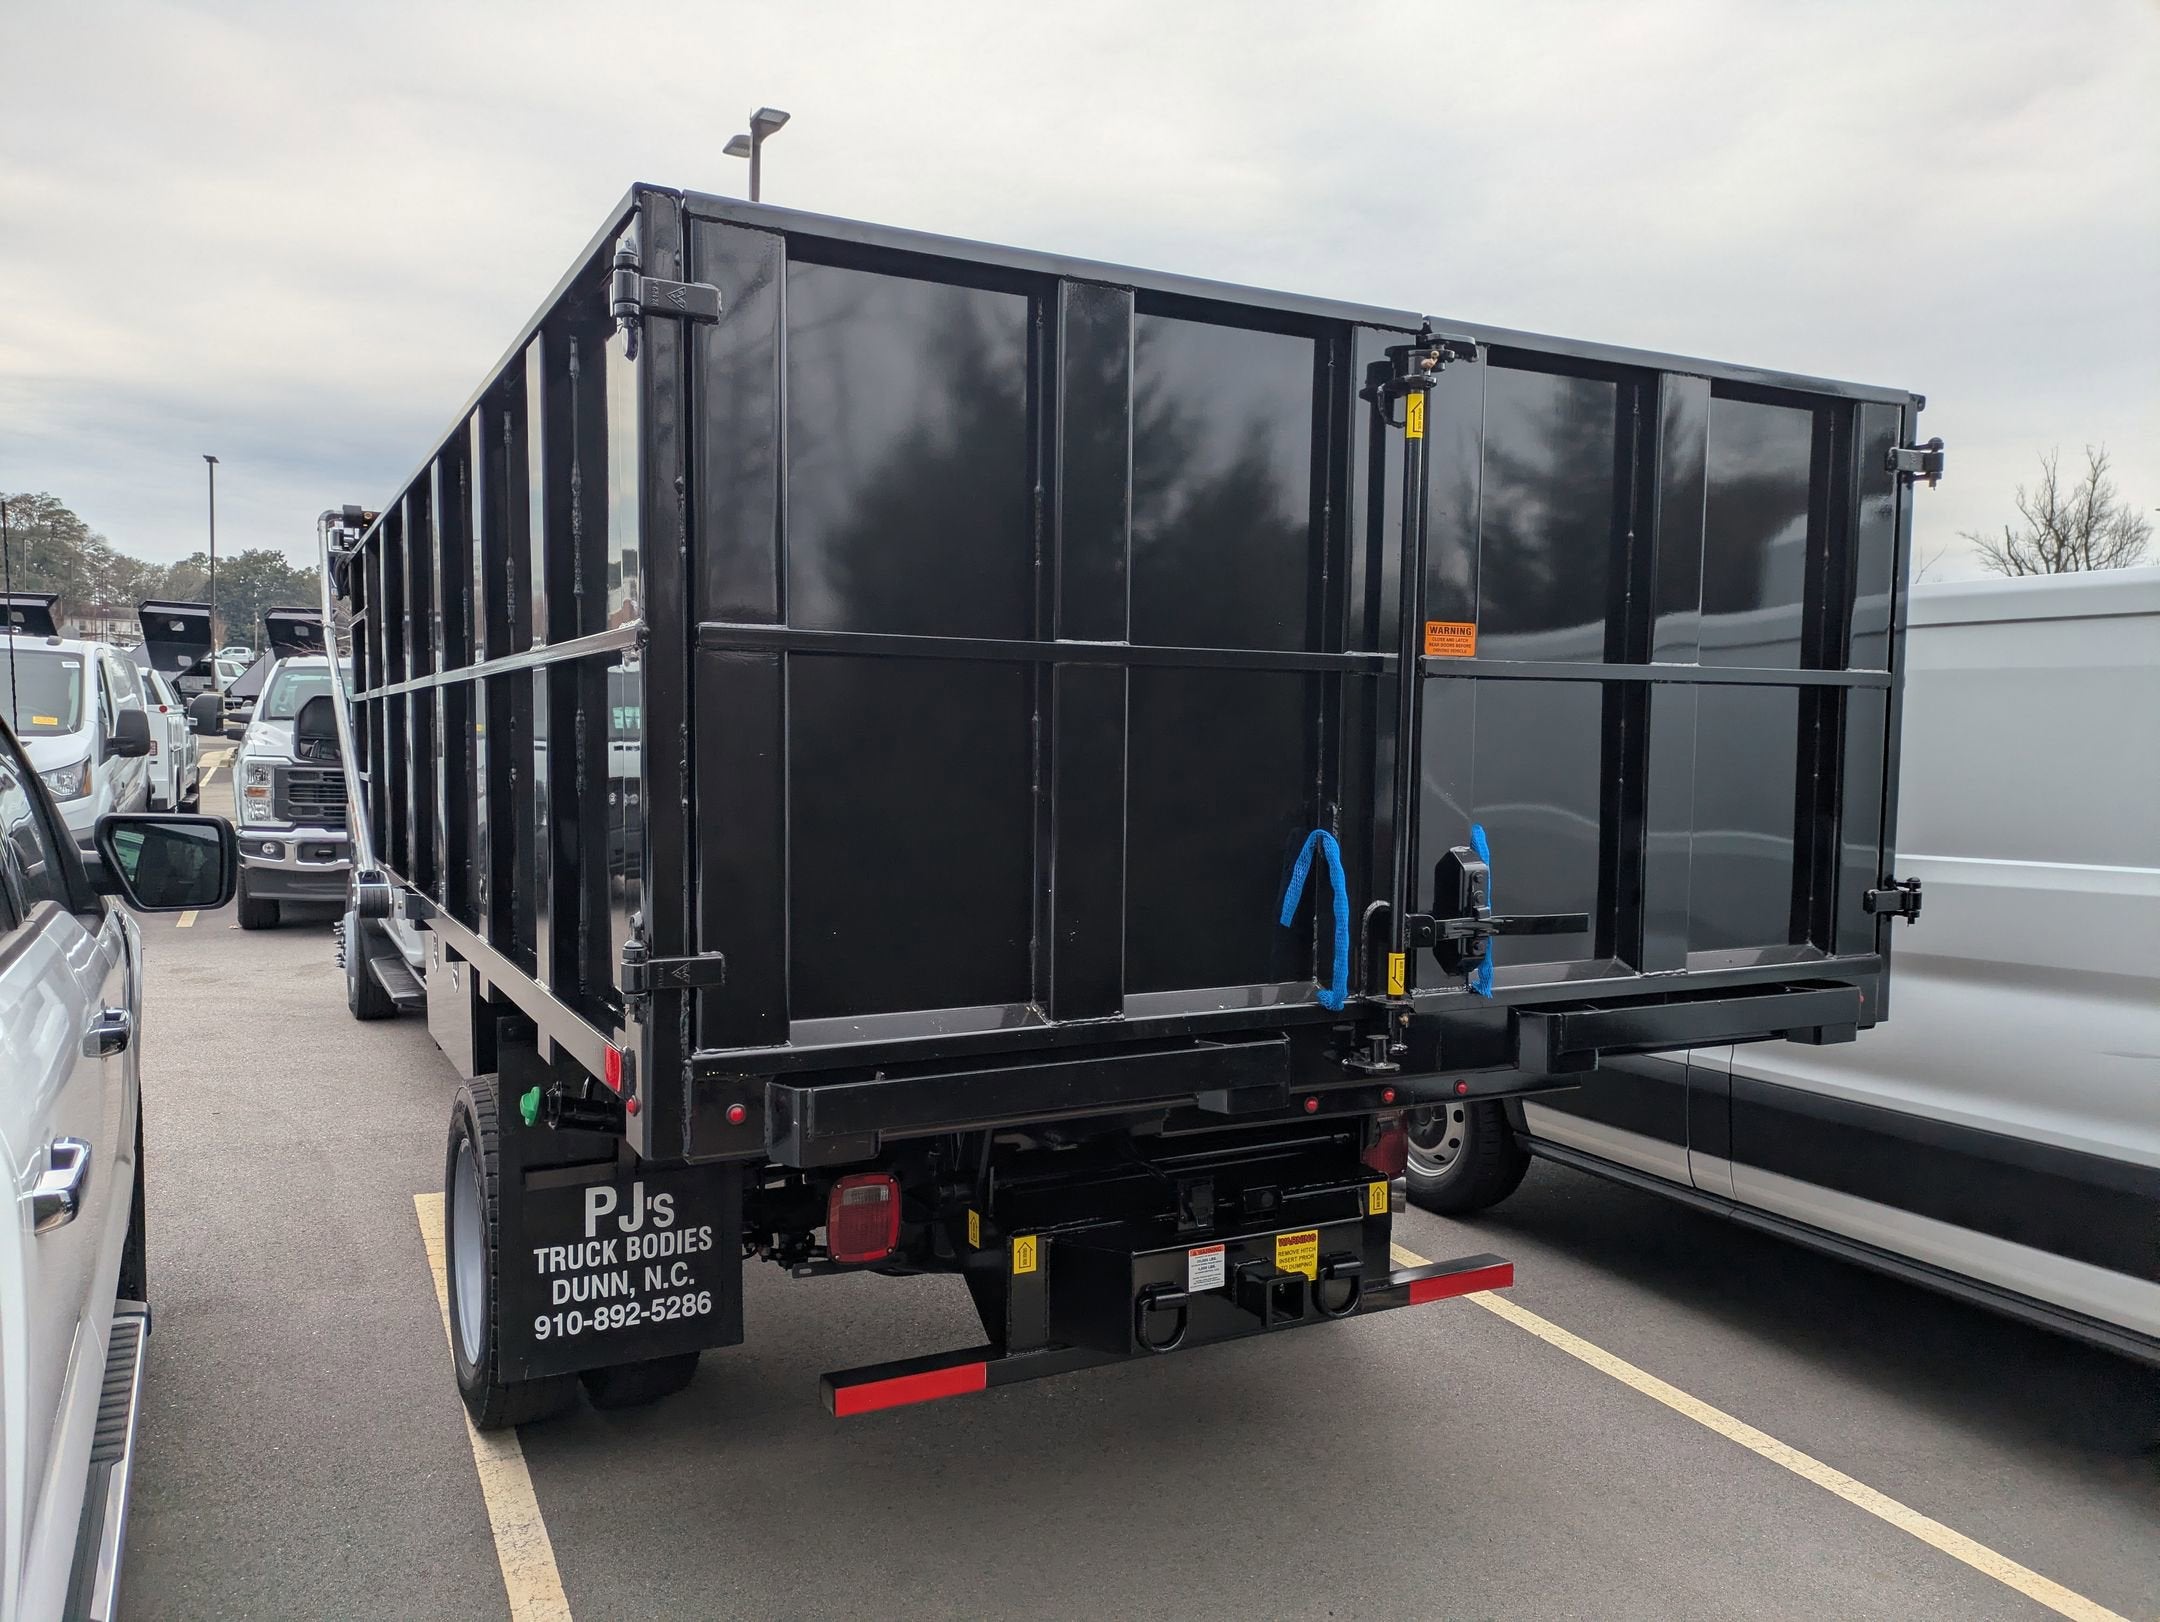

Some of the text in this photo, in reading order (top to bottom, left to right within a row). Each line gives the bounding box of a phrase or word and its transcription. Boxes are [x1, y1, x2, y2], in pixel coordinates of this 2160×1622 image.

[1430, 627, 1471, 635] WARNING
[1278, 1233, 1317, 1247] WARNING
[533, 1225, 713, 1274] TRUCK BODIES
[1279, 1256, 1298, 1264] INSERT
[1289, 1261, 1313, 1269] DUMPING
[552, 1261, 695, 1305] DUNN, N.C.
[534, 1291, 712, 1341] 910-892-5286
